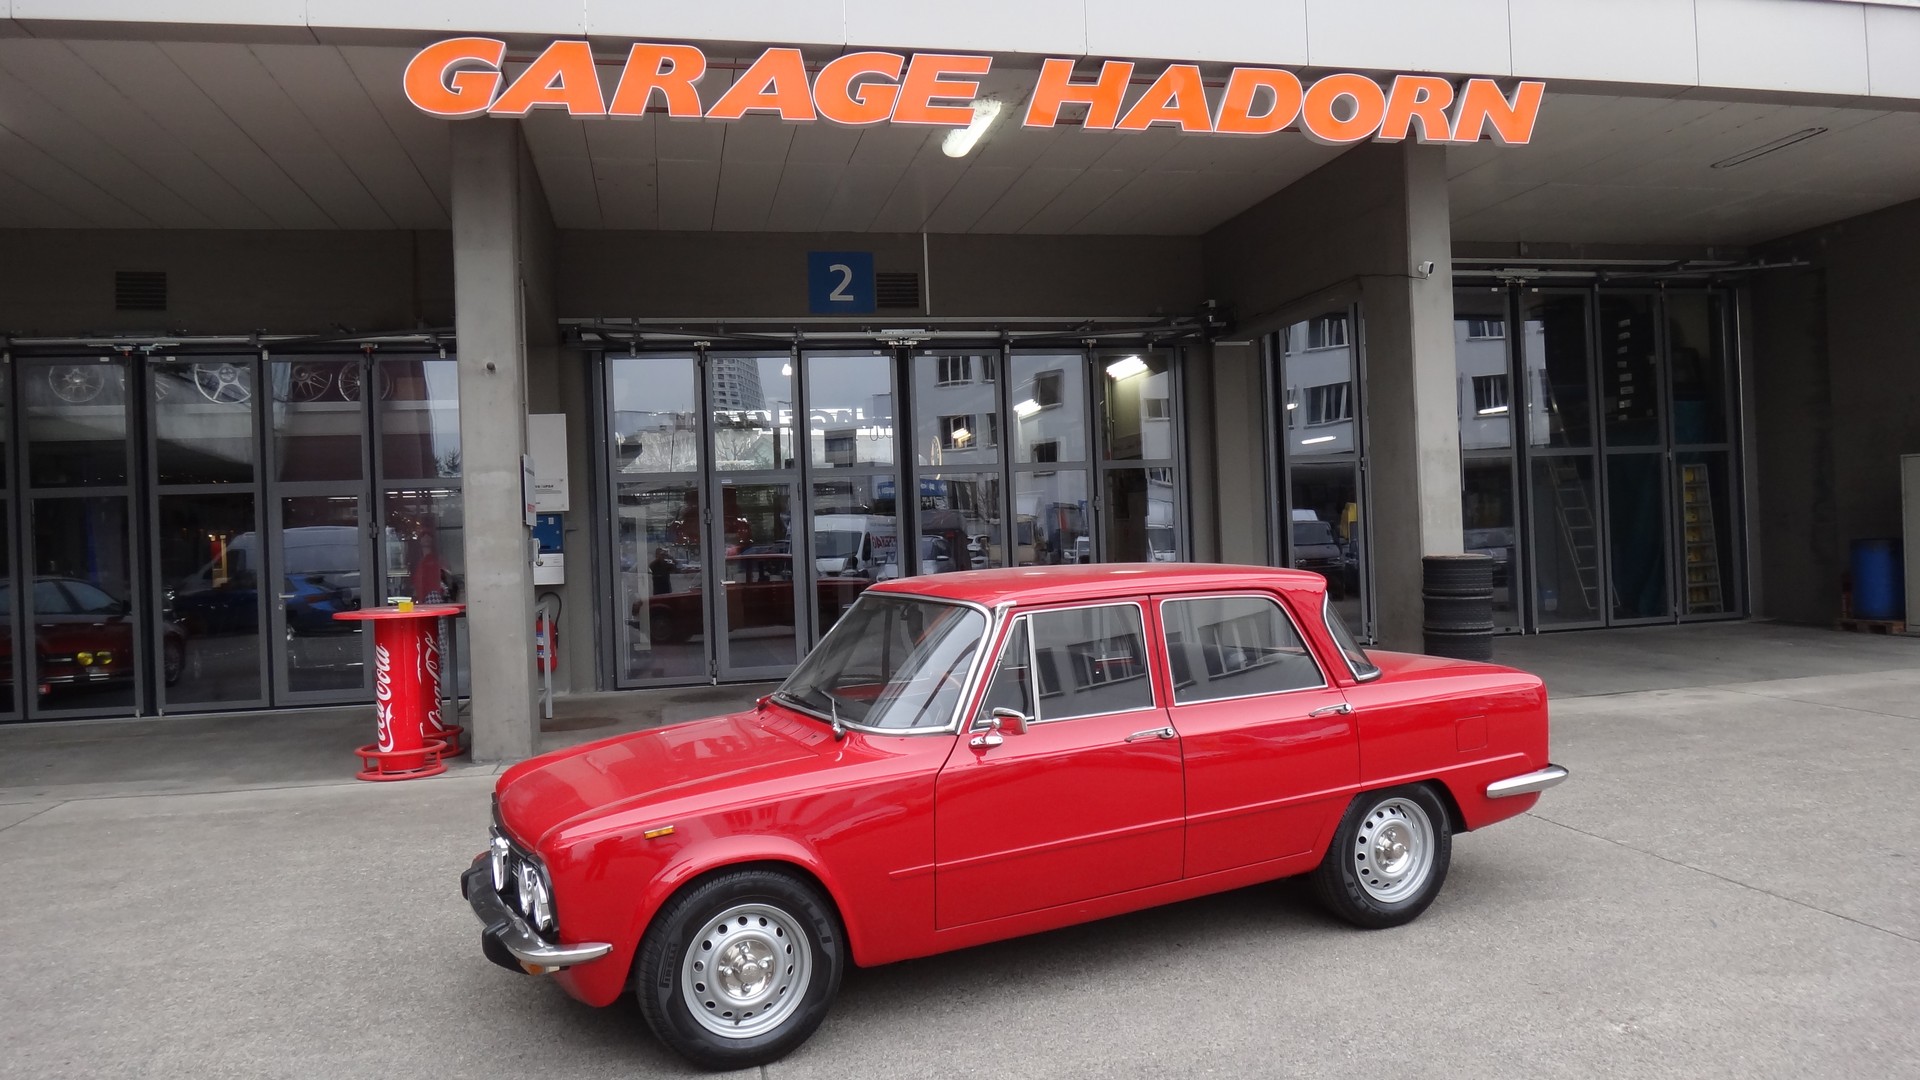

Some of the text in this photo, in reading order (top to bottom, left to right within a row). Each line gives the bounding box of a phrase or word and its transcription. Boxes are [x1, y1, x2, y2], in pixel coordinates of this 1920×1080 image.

[403, 36, 1546, 145] GARAGE HADORN
[828, 263, 855, 302] 2
